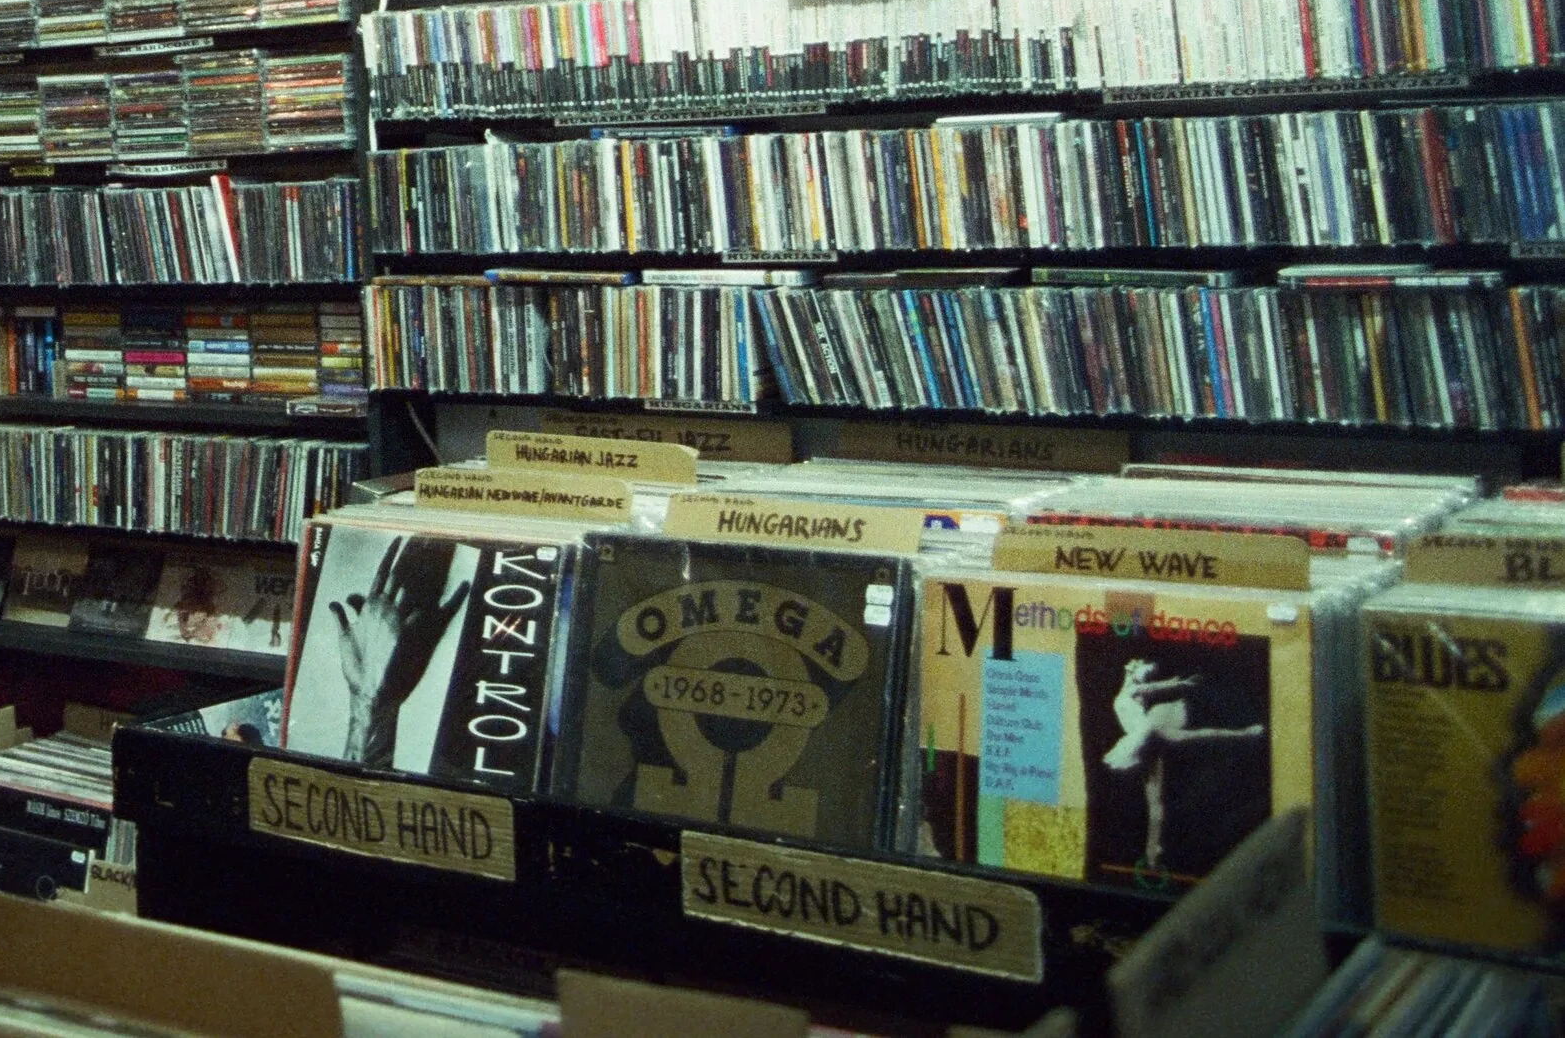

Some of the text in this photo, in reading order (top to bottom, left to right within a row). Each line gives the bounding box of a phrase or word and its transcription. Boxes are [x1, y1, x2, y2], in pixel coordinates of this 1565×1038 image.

[1112, 78, 1459, 101] HUNGARIAN CONTEMPORARY JAZZ
[559, 104, 819, 124] HUNGARIAN CONTEMPORARY JAZZ
[727, 252, 831, 260] HUNGARIANS
[645, 400, 751, 411] HUNGARIANS
[515, 443, 638, 468] HUNGARIAN JAZZ
[898, 431, 1055, 462] HUNGARIANS
[418, 483, 485, 500] HUNGARIAN
[717, 509, 867, 542] HUNGARIANS
[1053, 545, 1219, 580] NEW WAVE
[634, 589, 846, 668] OMEGA
[937, 581, 1109, 662] Methods
[1148, 609, 1238, 648] dance
[1372, 632, 1510, 693] BLUES
[261, 772, 493, 862] SECOND HAND
[692, 860, 1000, 952] SECOND HAND
